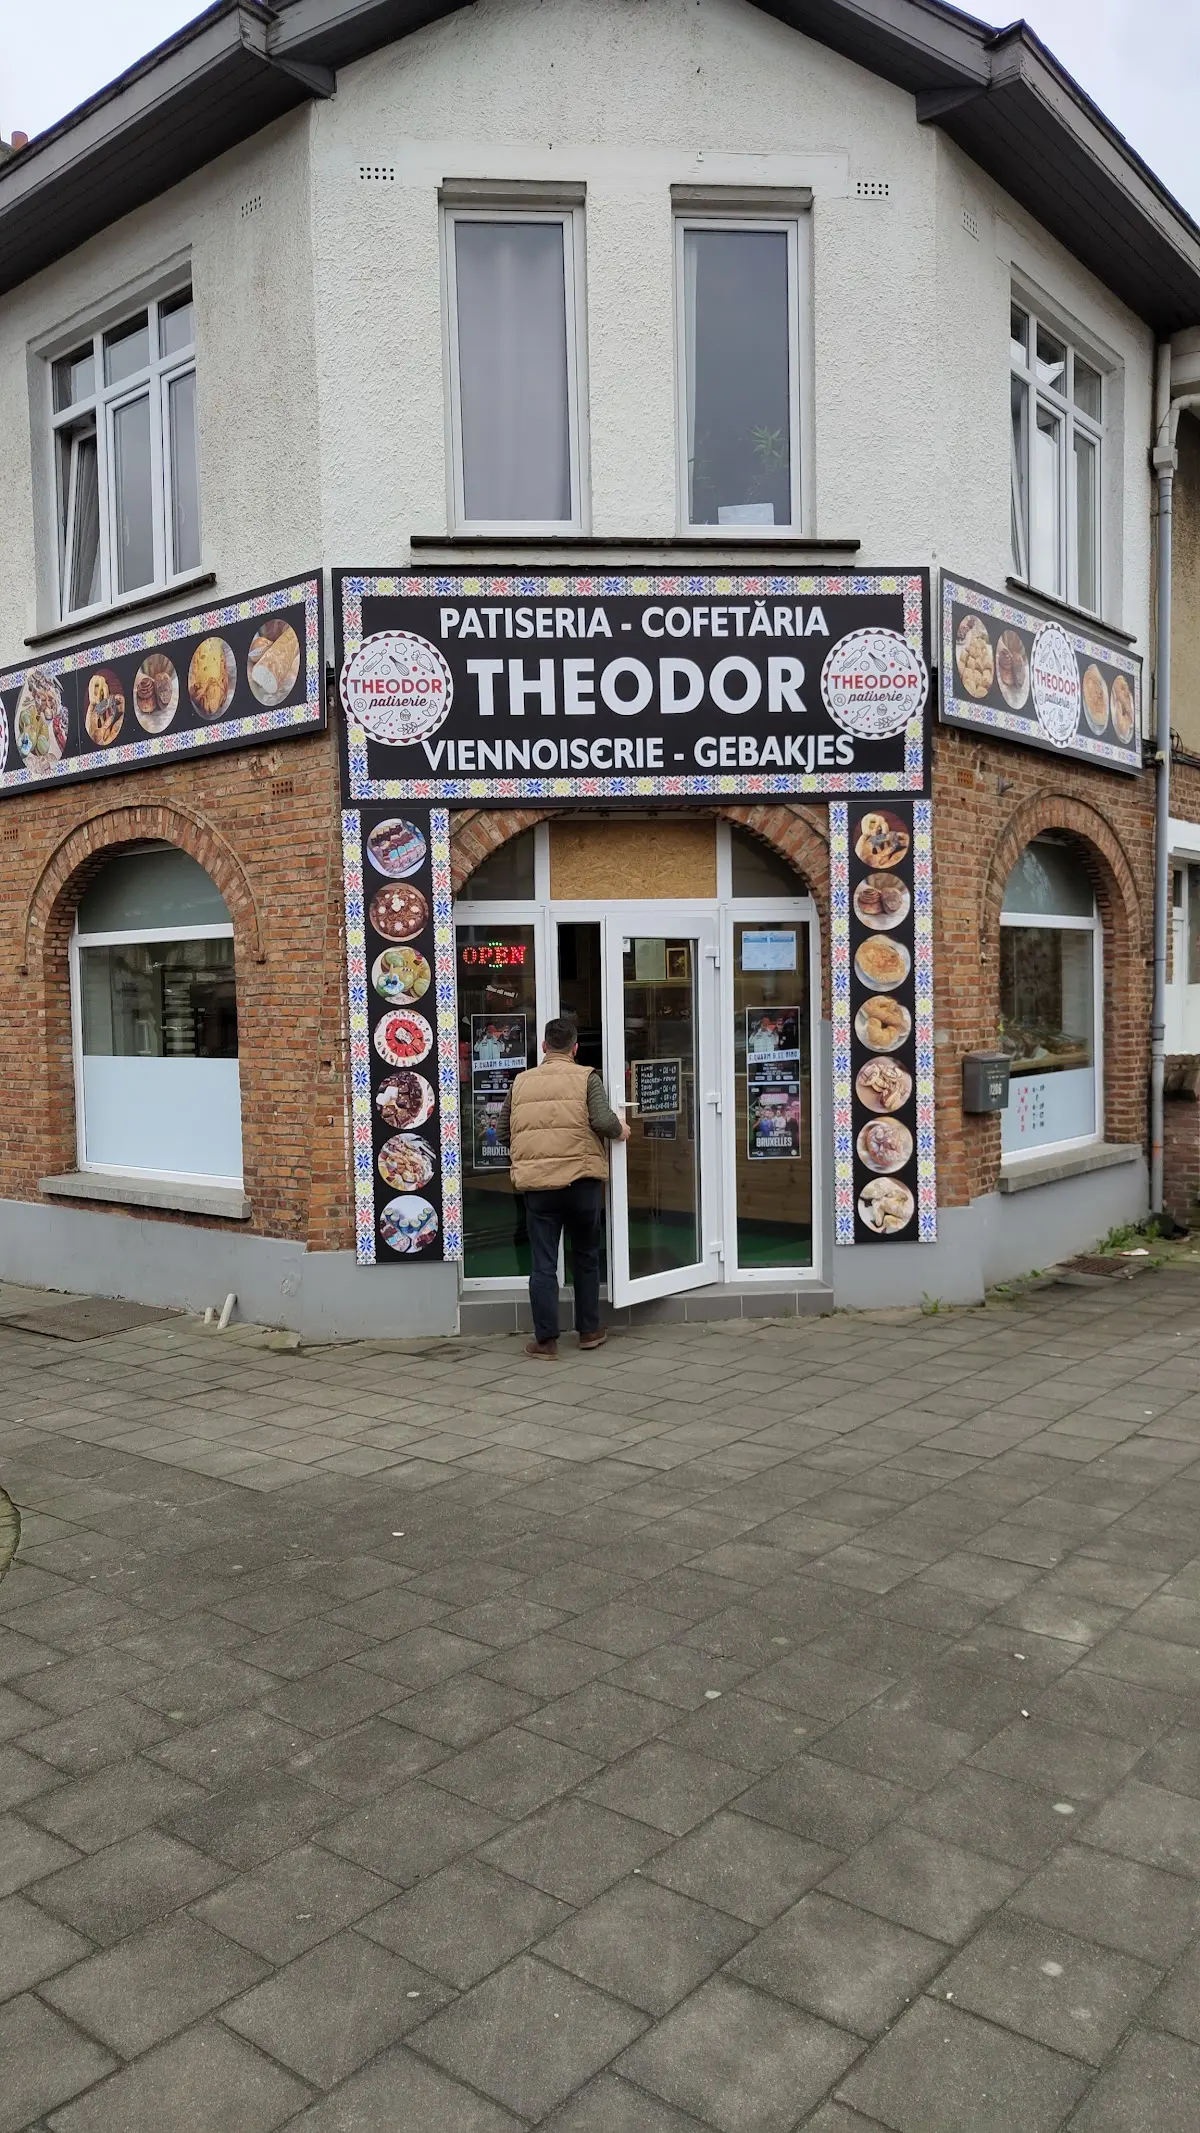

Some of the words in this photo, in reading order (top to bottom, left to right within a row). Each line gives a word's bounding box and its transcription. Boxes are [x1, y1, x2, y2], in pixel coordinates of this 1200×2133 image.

[440, 607, 613, 638] PATISERIA
[641, 600, 830, 638] COFETĂRIA
[350, 678, 443, 694] THEODOR
[466, 656, 808, 716] THEODOR
[830, 674, 918, 690] THEODOR
[1035, 668, 1076, 698] THEODOR
[368, 695, 428, 710] patiserie
[847, 691, 904, 704] patiserie
[421, 738, 664, 771] VIENNOISERIE
[694, 735, 855, 774] GEBAKJES
[463, 946, 526, 964] OPEN
[756, 1137, 792, 1147] BRUXELLES
